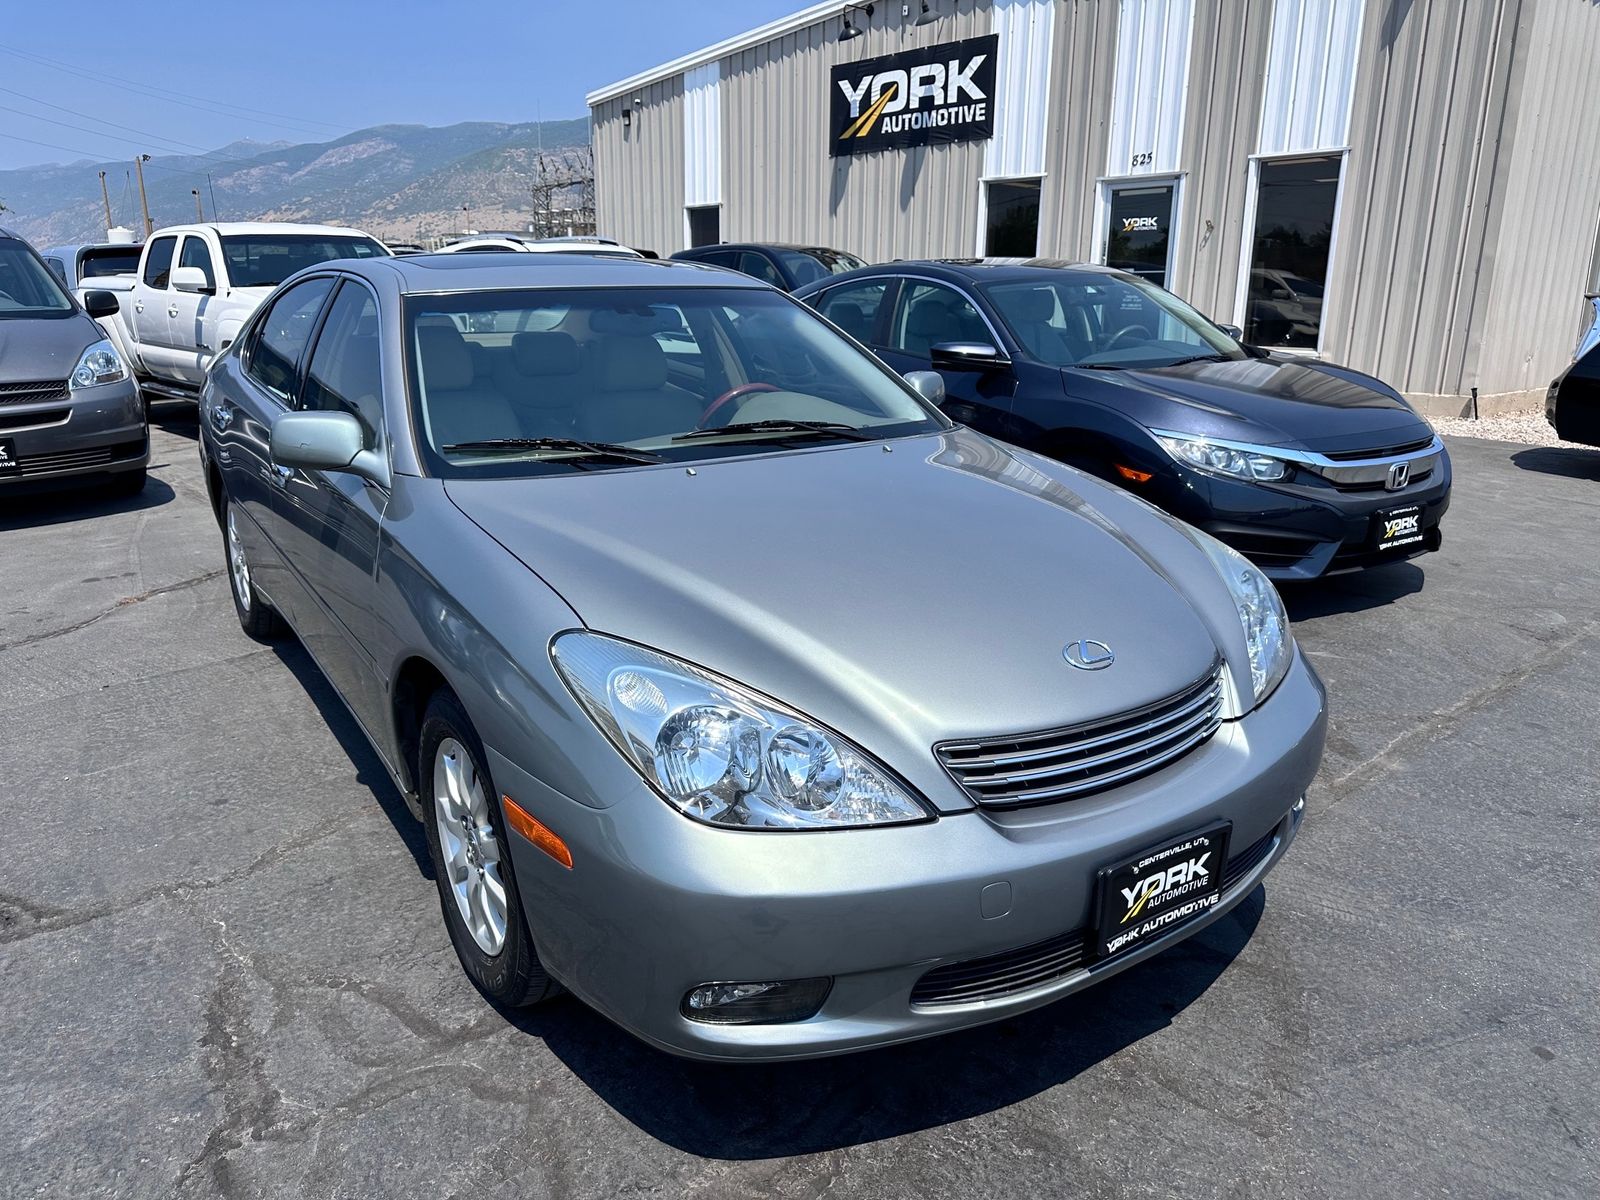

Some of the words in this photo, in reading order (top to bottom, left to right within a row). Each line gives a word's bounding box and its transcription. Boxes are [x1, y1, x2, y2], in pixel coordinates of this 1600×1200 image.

[837, 54, 988, 118] YORK
[881, 103, 986, 134] AUTOMOTIVE
[1132, 152, 1153, 167] 825
[1122, 216, 1158, 227] YORK
[1384, 515, 1419, 532] YORK
[1121, 851, 1212, 909] YORK
[1147, 875, 1209, 909] AUTOMOTIVE
[1141, 894, 1219, 935] AUTOMOTIVE
